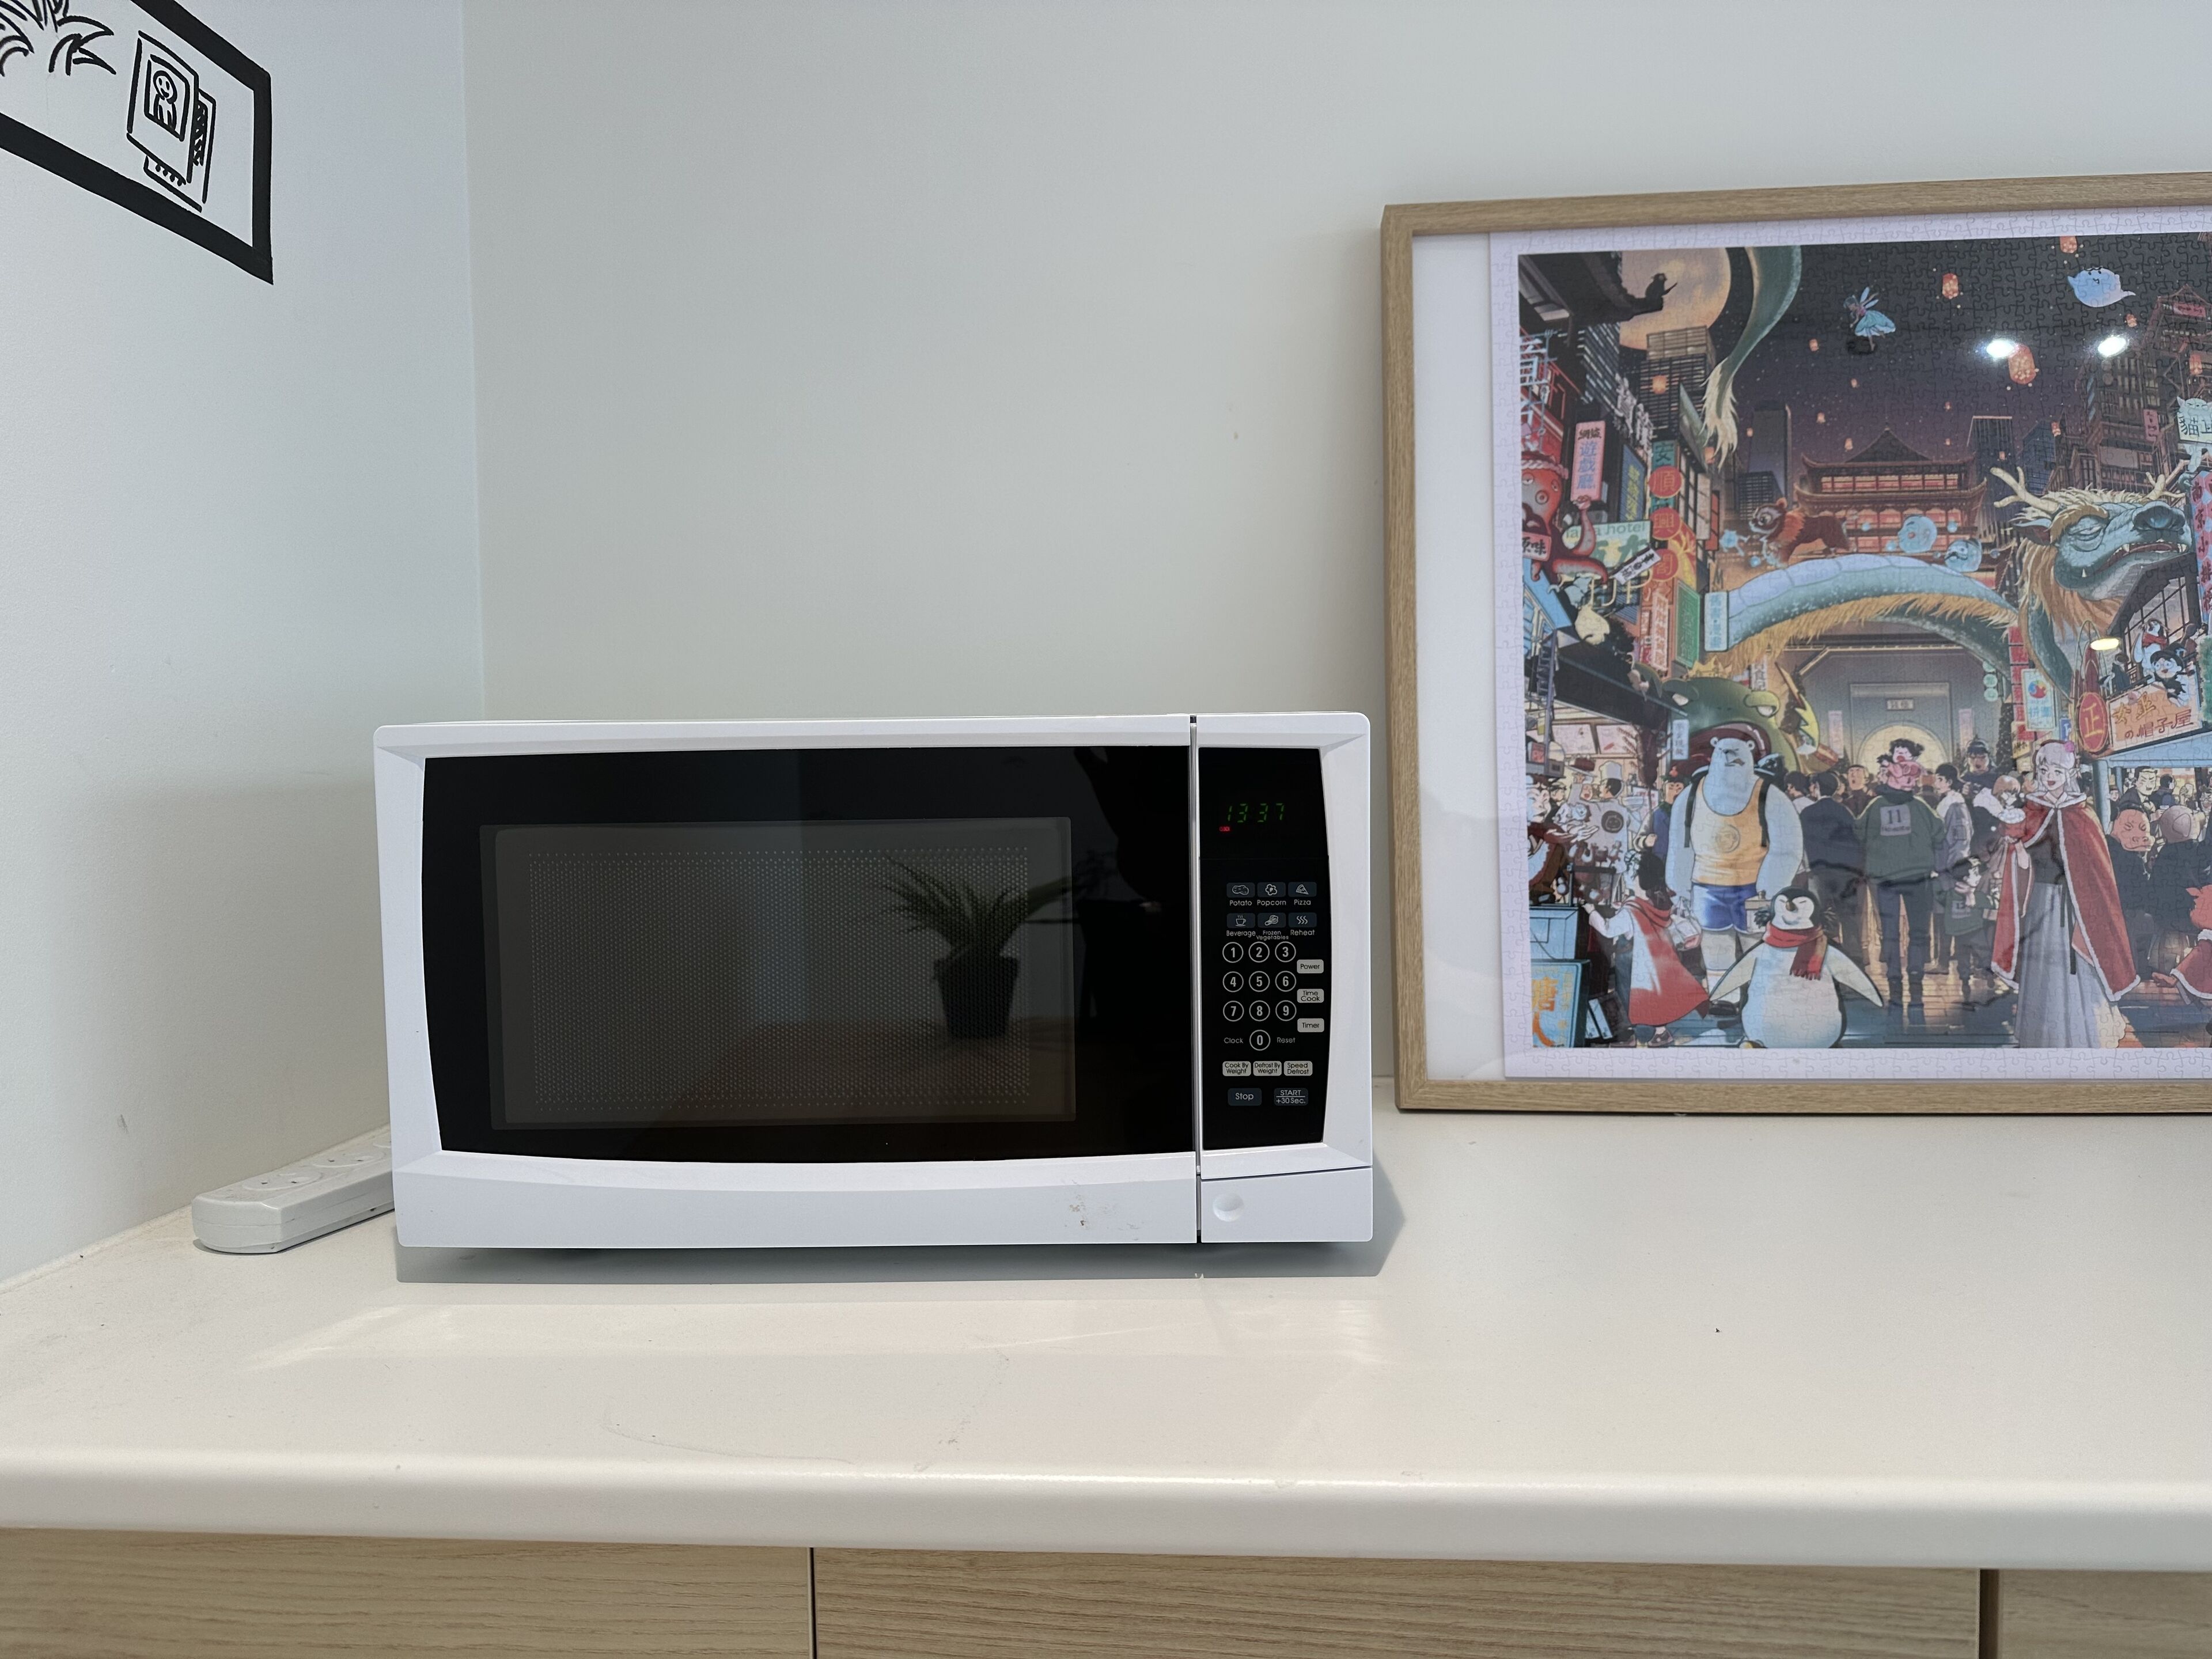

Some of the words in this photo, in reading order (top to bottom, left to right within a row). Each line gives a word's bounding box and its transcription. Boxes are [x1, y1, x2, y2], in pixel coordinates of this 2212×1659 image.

[1605, 522, 1646, 534] hotel
[2083, 702, 2103, 738] 正
[2124, 709, 2194, 739] の帽子屋
[1888, 809, 1902, 824] 11
[1226, 930, 1256, 938] Beverage
[1230, 947, 1236, 958] 1
[1256, 946, 1263, 957] 2
[1282, 946, 1289, 957] 3
[1230, 976, 1237, 987] 4
[1256, 976, 1263, 987] 5
[1282, 976, 1289, 986] 6
[1230, 1006, 1237, 1017] 7
[1256, 1005, 1263, 1016] 8
[1283, 1005, 1289, 1016] 9
[1256, 1035, 1263, 1046] 0
[1235, 1093, 1254, 1101] Stop
